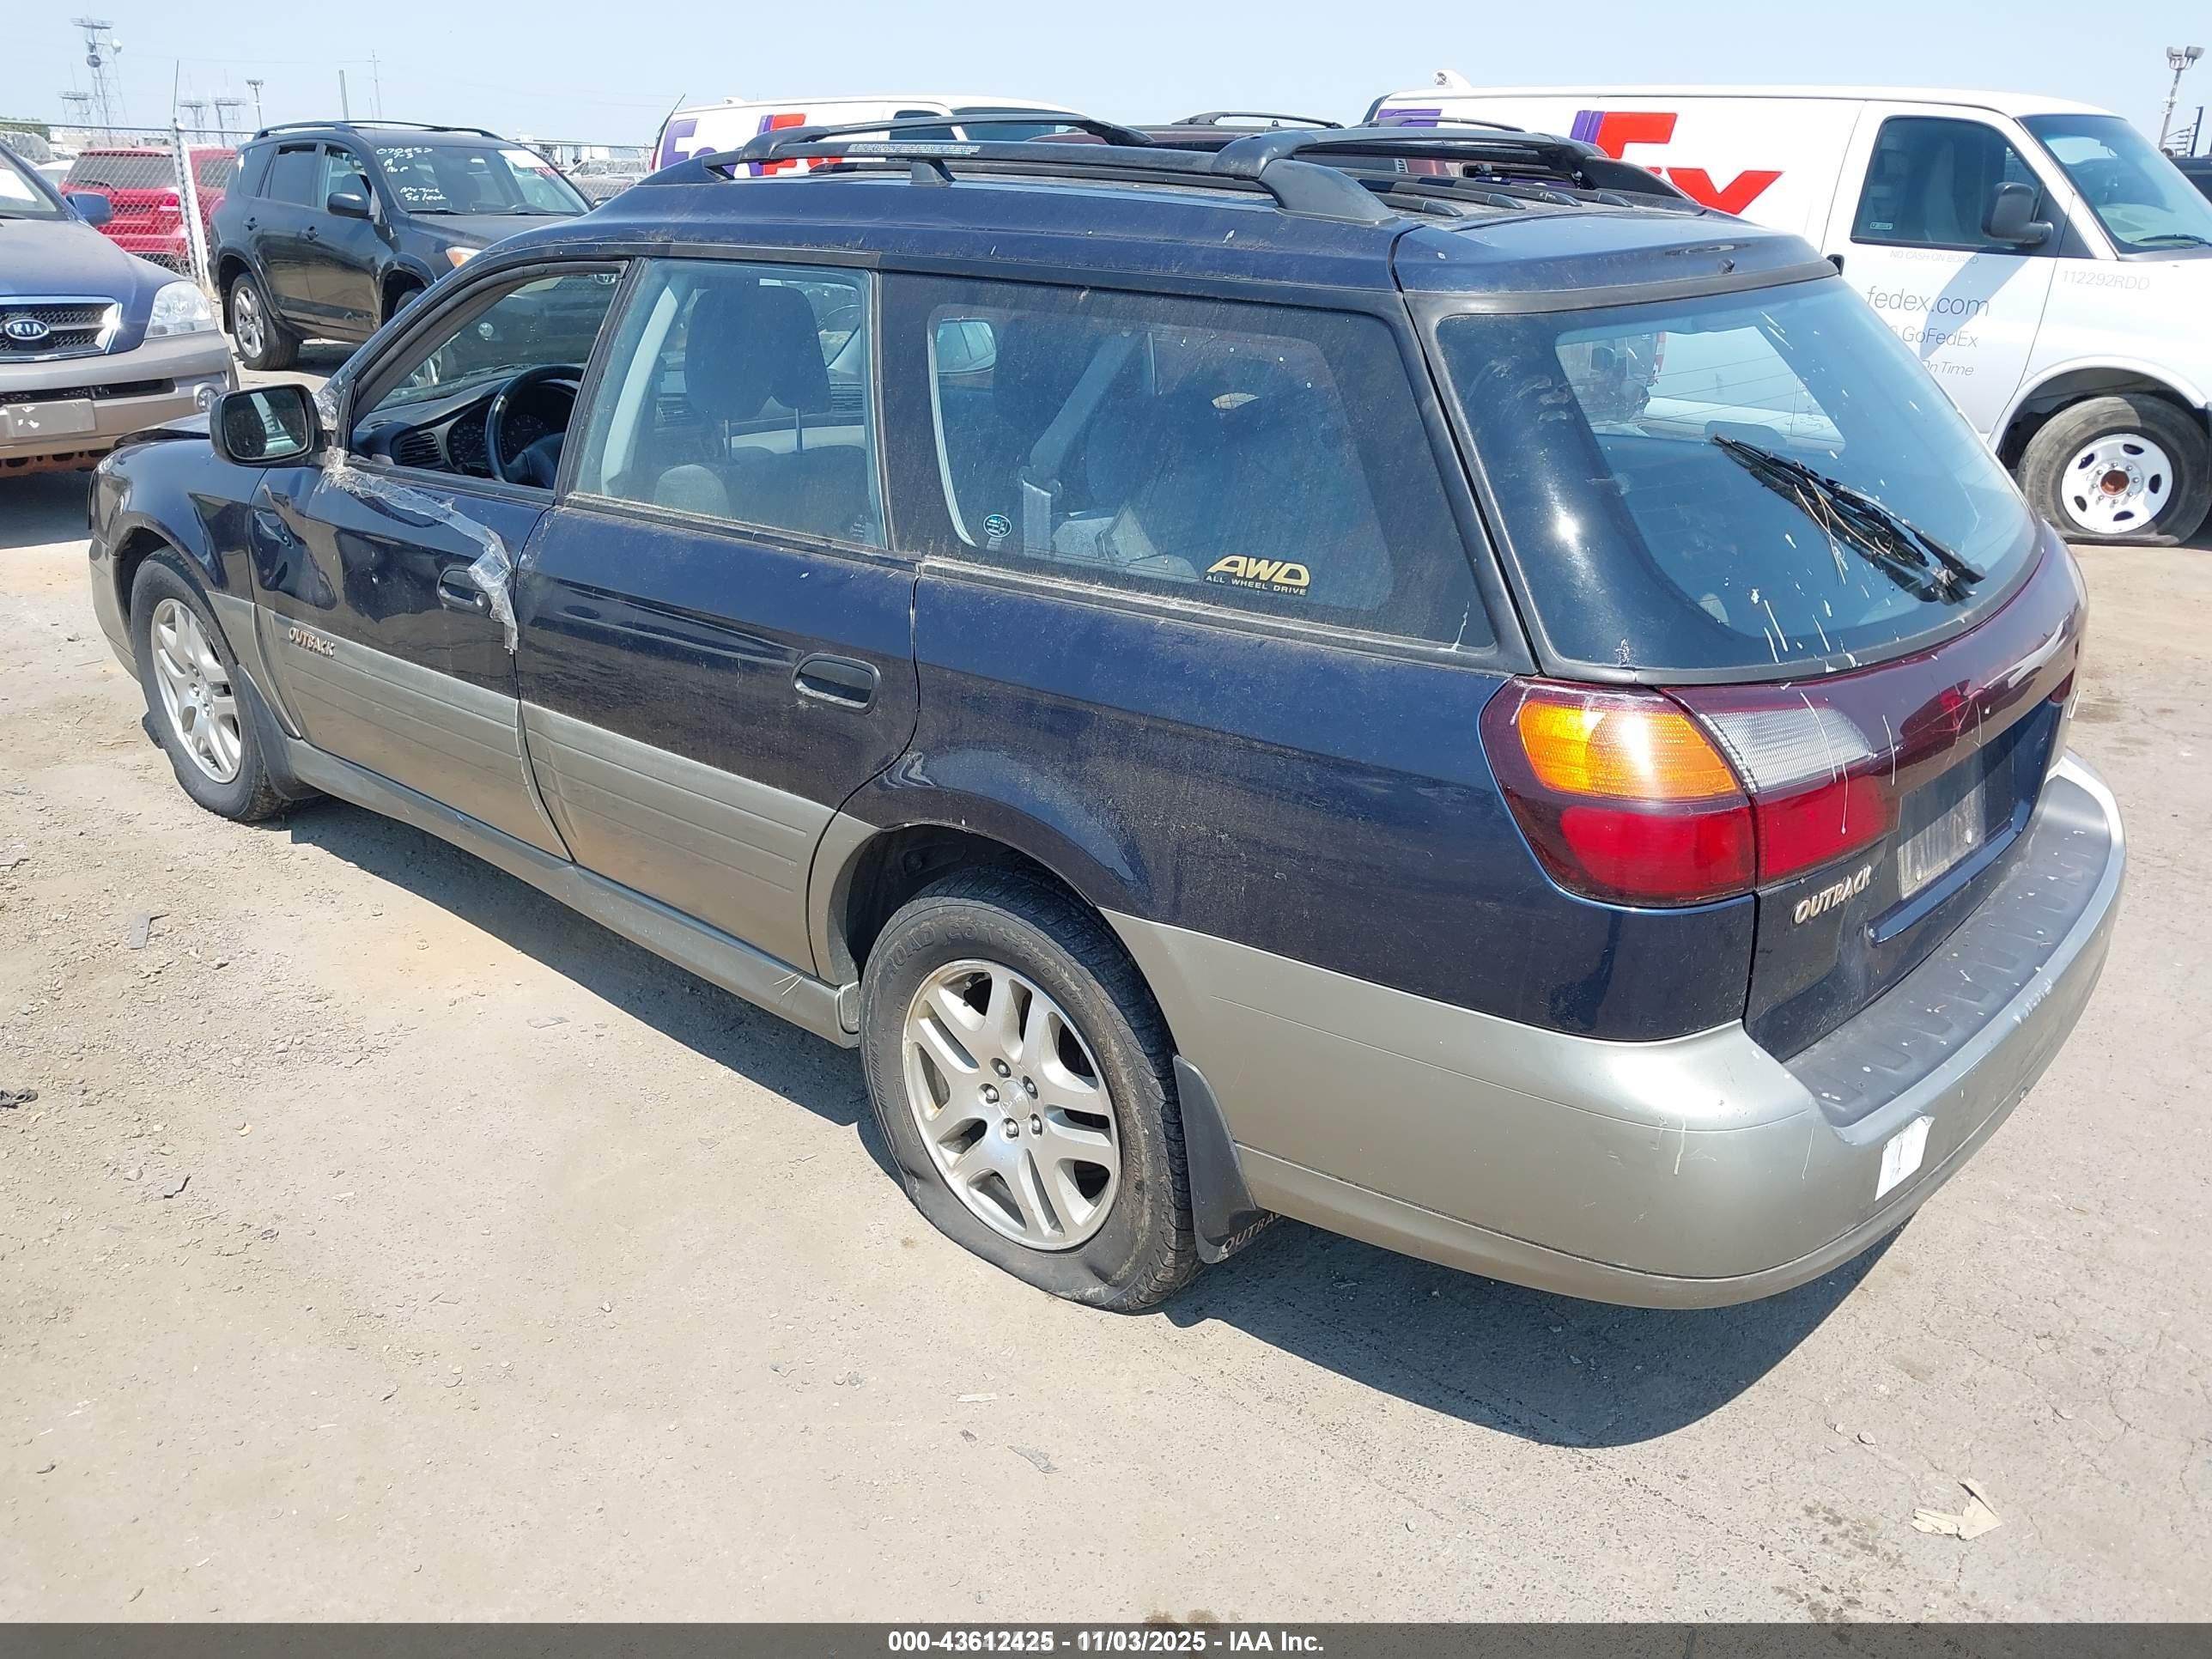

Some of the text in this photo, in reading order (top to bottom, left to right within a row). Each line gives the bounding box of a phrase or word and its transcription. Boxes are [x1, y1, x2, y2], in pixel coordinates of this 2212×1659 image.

[1889, 250, 1904, 258] NO
[1905, 251, 1930, 260] CASH
[1931, 252, 1945, 262] ON
[2061, 270, 2150, 290] 112292RDD
[1867, 286, 1990, 317] fedex.com
[13, 323, 43, 335] KIA
[1941, 361, 1975, 376] Time
[1206, 555, 1310, 586] AWD
[1231, 578, 1268, 590] WHEEL
[1273, 585, 1307, 596] DRIVE
[289, 626, 335, 656] OUTBACK
[1795, 864, 1873, 925] OUTBACK
